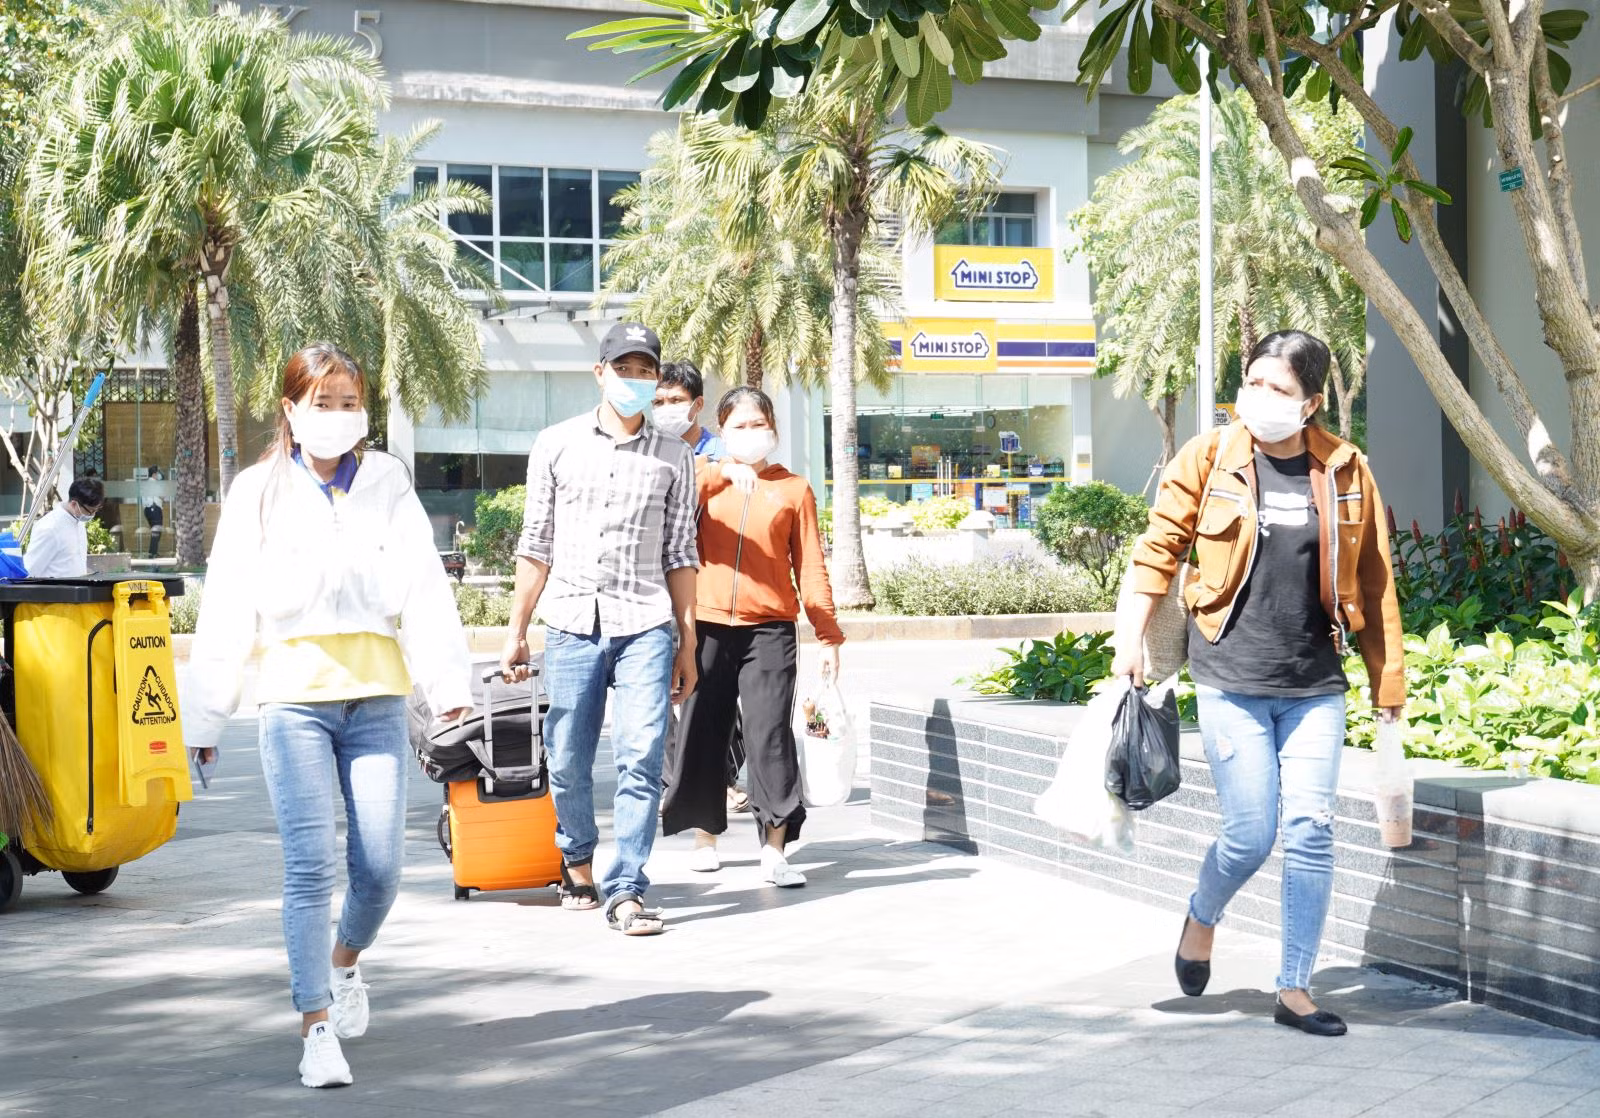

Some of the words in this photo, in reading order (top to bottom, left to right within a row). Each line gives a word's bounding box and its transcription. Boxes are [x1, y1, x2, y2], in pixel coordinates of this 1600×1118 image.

[961, 271, 992, 284] MINI
[997, 271, 1031, 284] STOP
[919, 342, 948, 354] MINI
[951, 342, 983, 354] STOP
[130, 636, 166, 649] CAUTION
[133, 676, 148, 712] CAUTION
[155, 676, 174, 709] CUIDADO
[139, 716, 171, 726] ATTENTION
